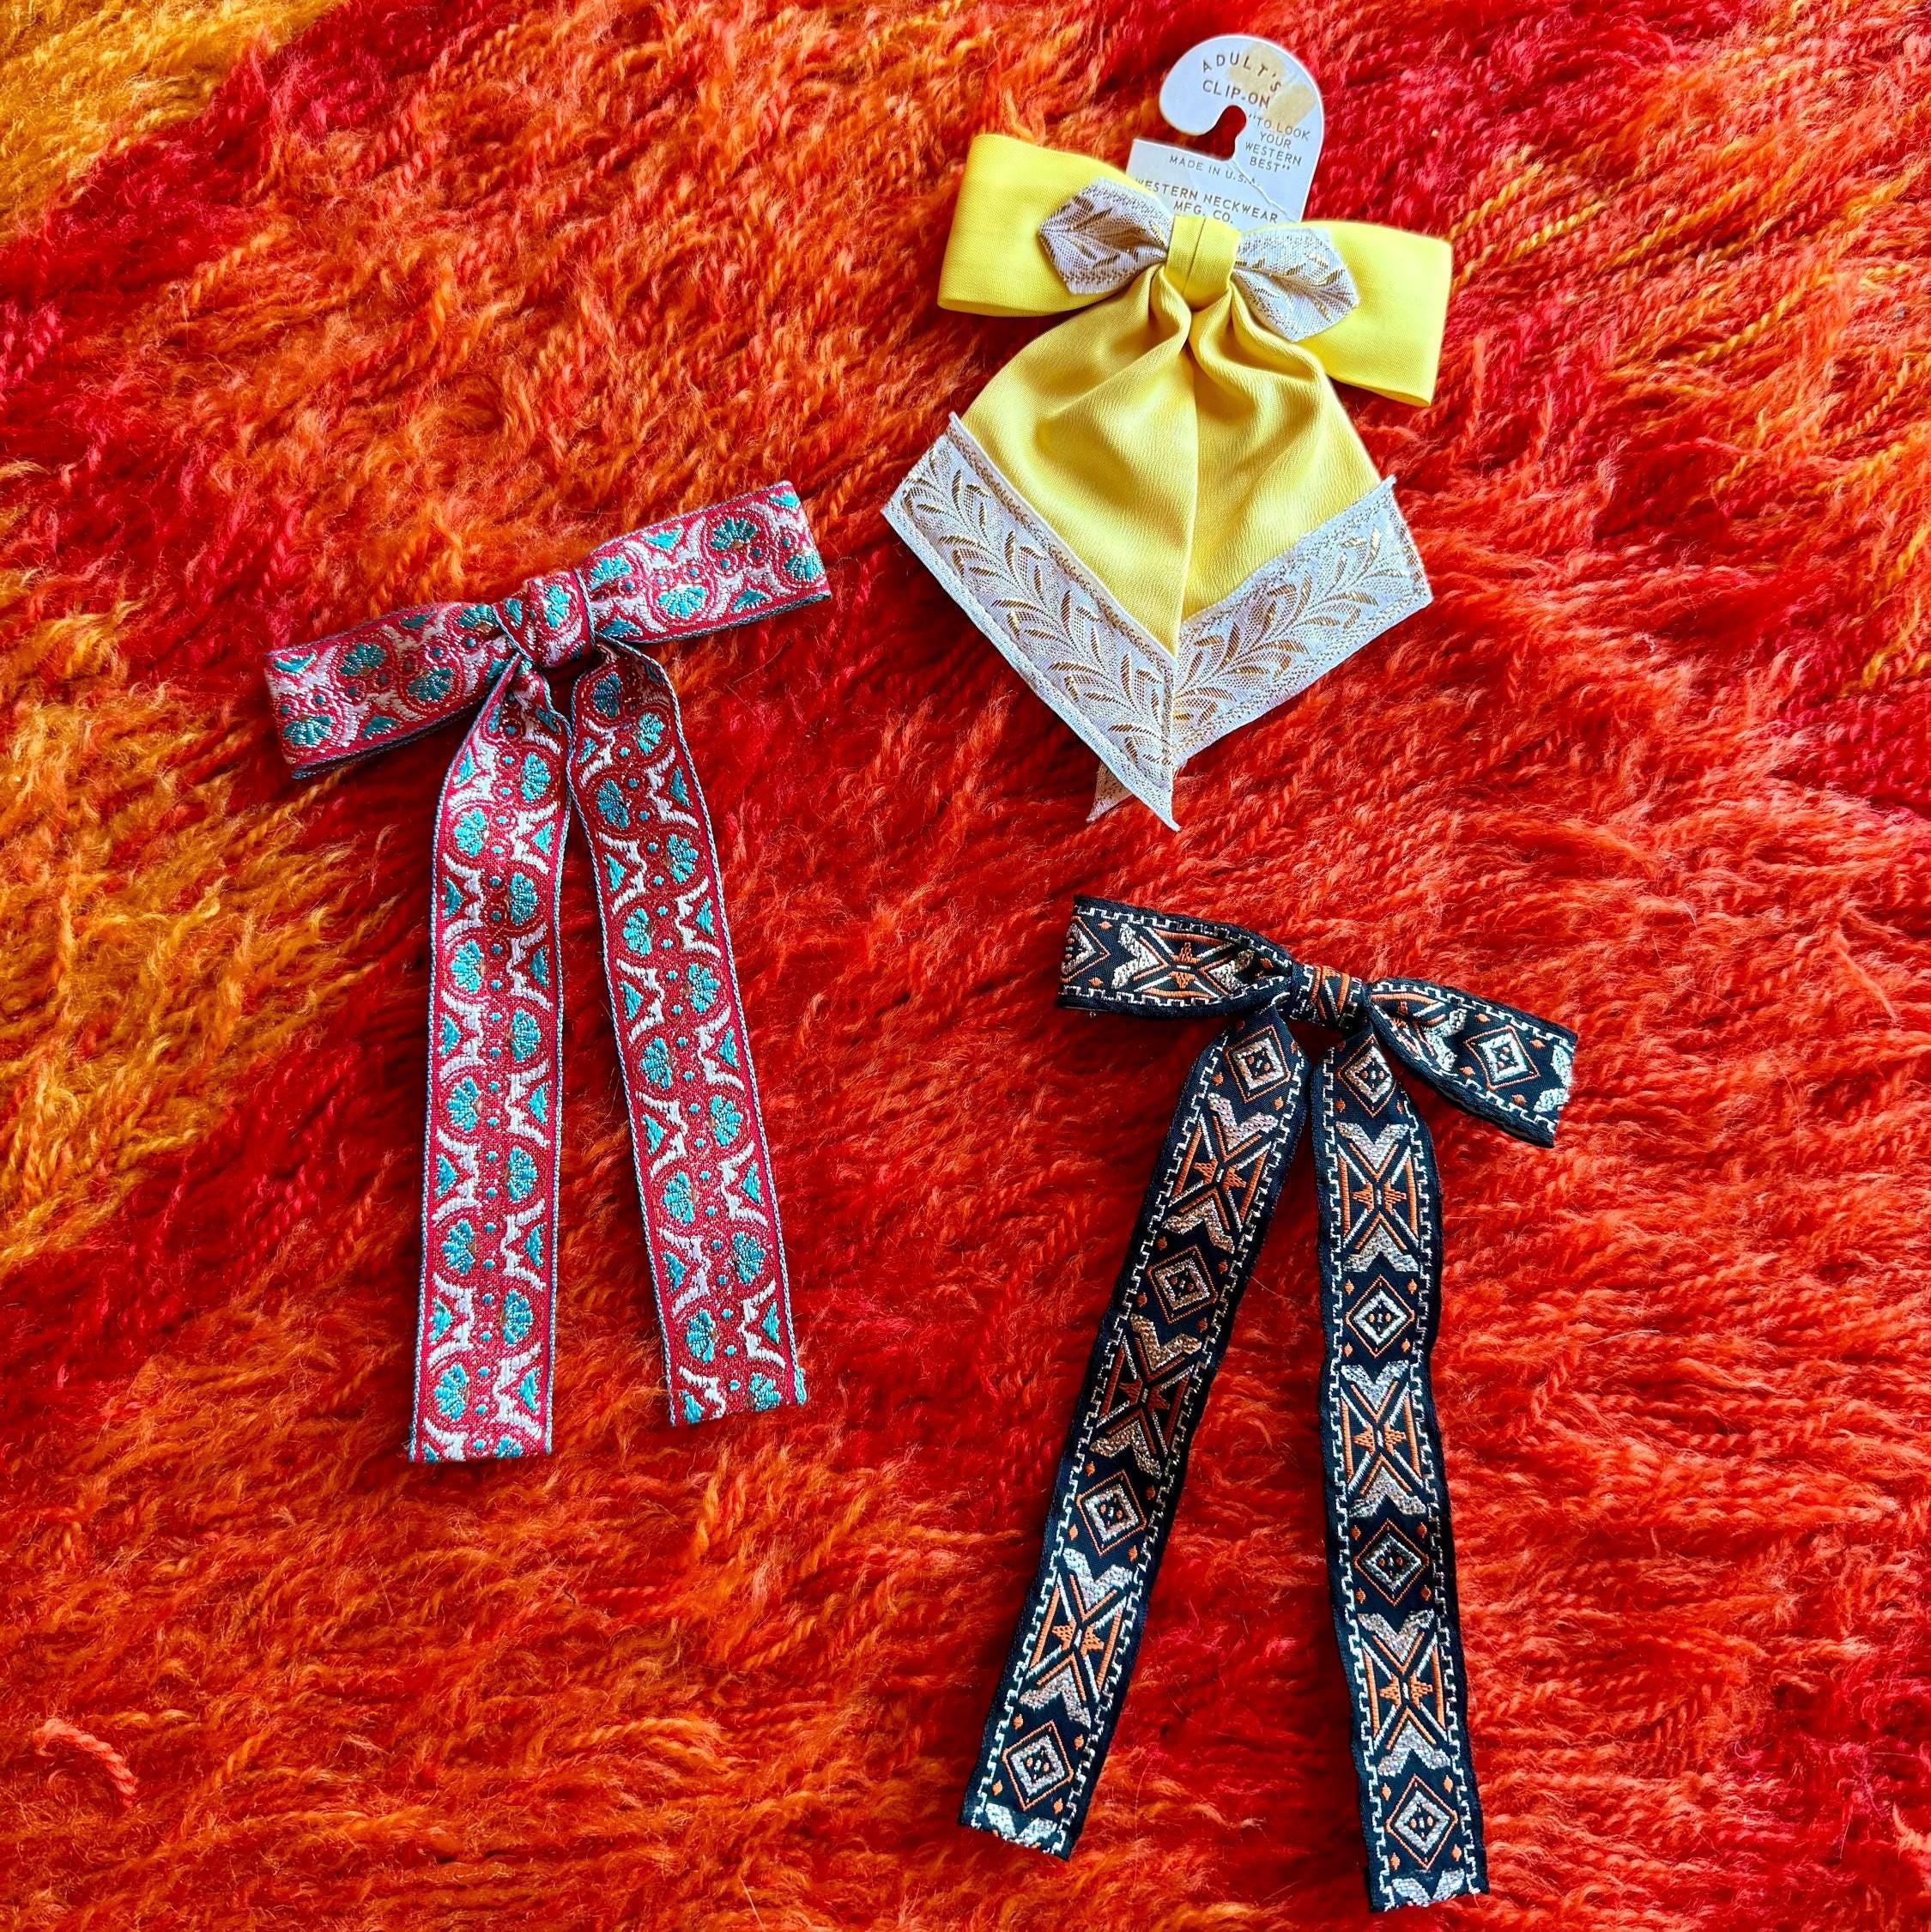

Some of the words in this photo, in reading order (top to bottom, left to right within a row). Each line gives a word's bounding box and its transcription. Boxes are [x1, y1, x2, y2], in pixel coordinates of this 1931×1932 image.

[1202, 52, 1281, 93] ADULT'S
[1202, 80, 1270, 109] CLIP-ON
[1260, 130, 1292, 150] YOUR
[1276, 122, 1311, 142] LOOK
[1169, 154, 1203, 171] MADE
[1208, 166, 1220, 177] IN
[1245, 142, 1302, 167] WESTERN
[1173, 200, 1206, 217] MFG.
[1213, 209, 1234, 225] CO.
[1203, 193, 1278, 224] NECKWEAR
